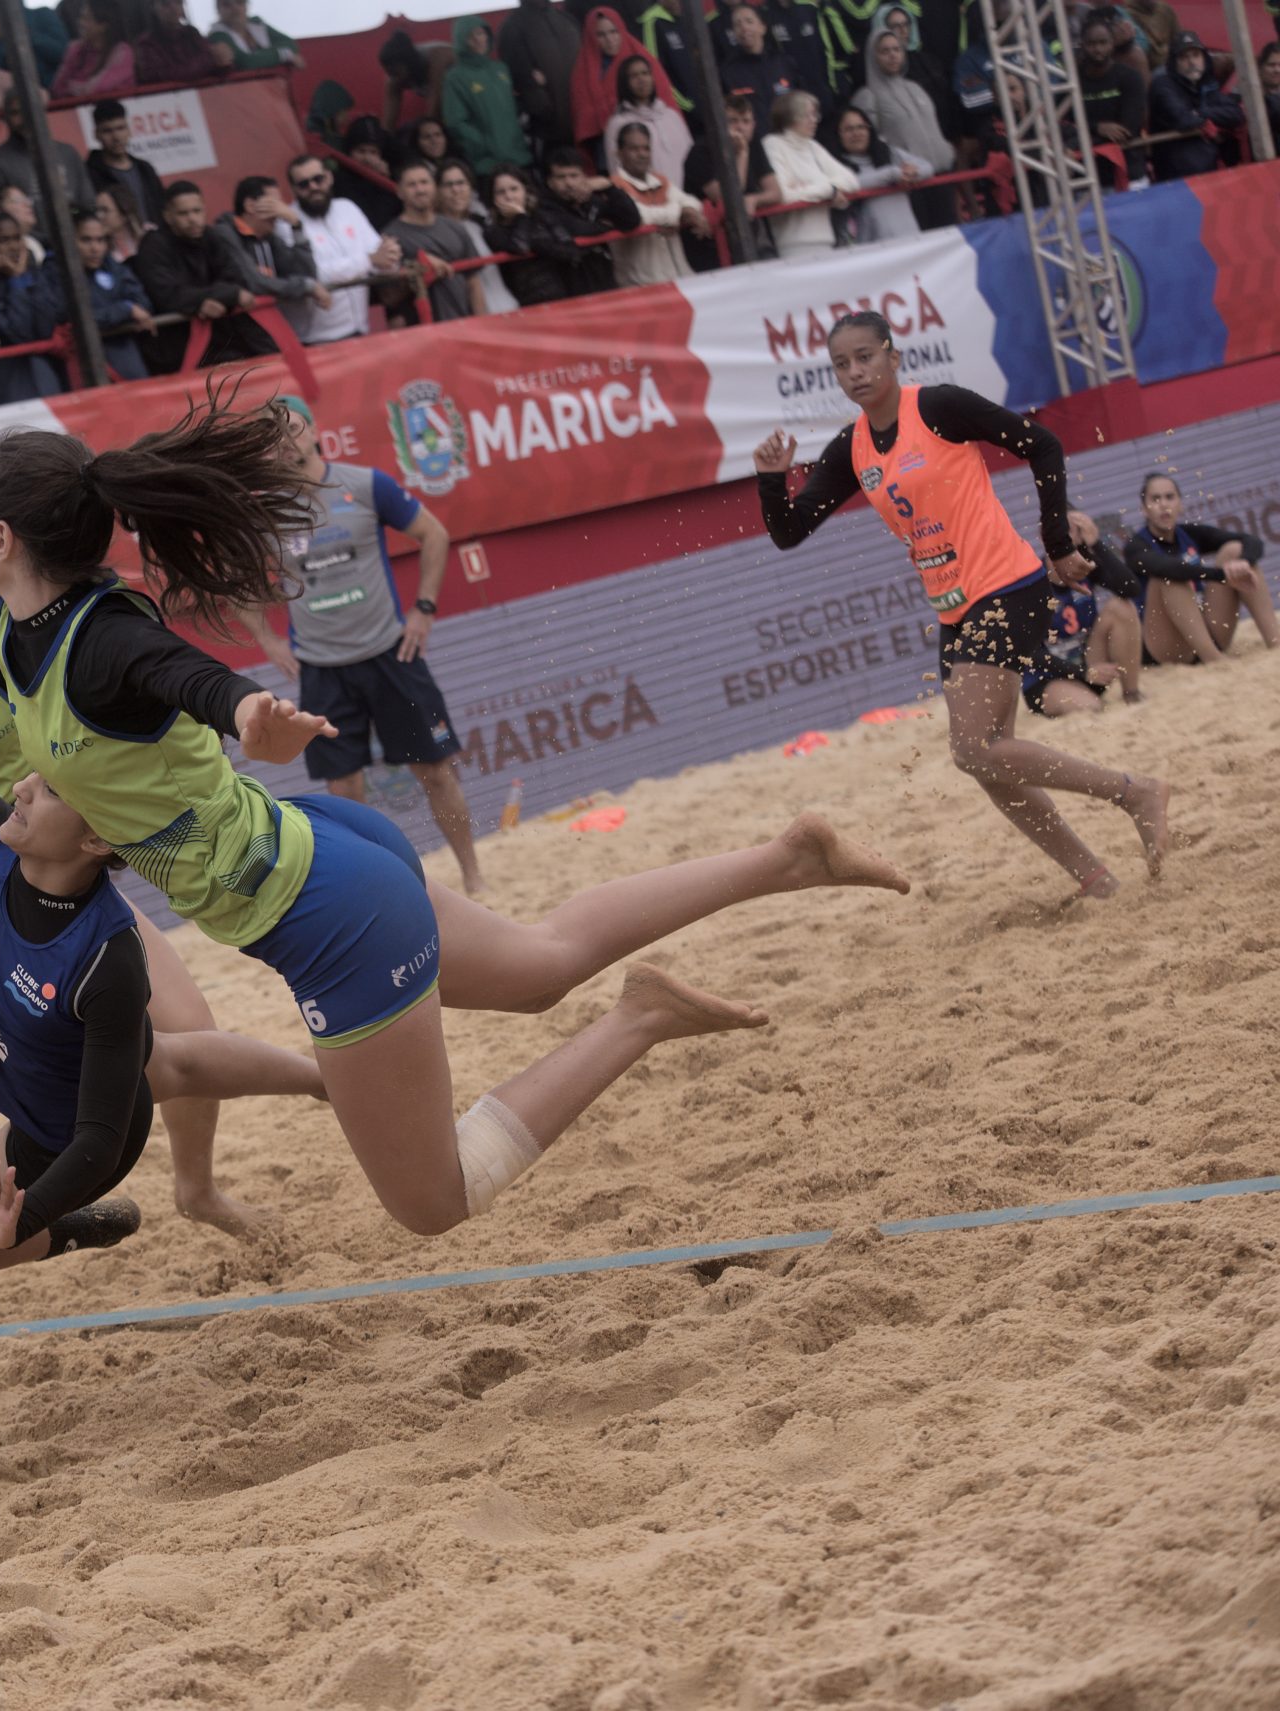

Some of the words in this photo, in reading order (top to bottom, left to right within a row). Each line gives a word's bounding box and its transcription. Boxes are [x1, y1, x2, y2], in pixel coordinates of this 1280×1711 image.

[494, 361, 603, 397] PREFEITURA
[608, 352, 636, 377] DE
[777, 365, 837, 398] CAPIT
[469, 366, 678, 466] MARICÁ
[886, 482, 914, 518] 5
[30, 599, 70, 628] KIPSTA
[756, 575, 928, 651] SECRETAR
[1061, 605, 1080, 635] 3
[723, 633, 883, 708] ESPORTE
[889, 624, 913, 657] E
[58, 737, 95, 757] IDEC
[452, 671, 661, 782] MARICÁ
[408, 934, 439, 975] IDEC
[10, 970, 49, 1012] MOGIANO
[16, 963, 40, 992] CLUBE
